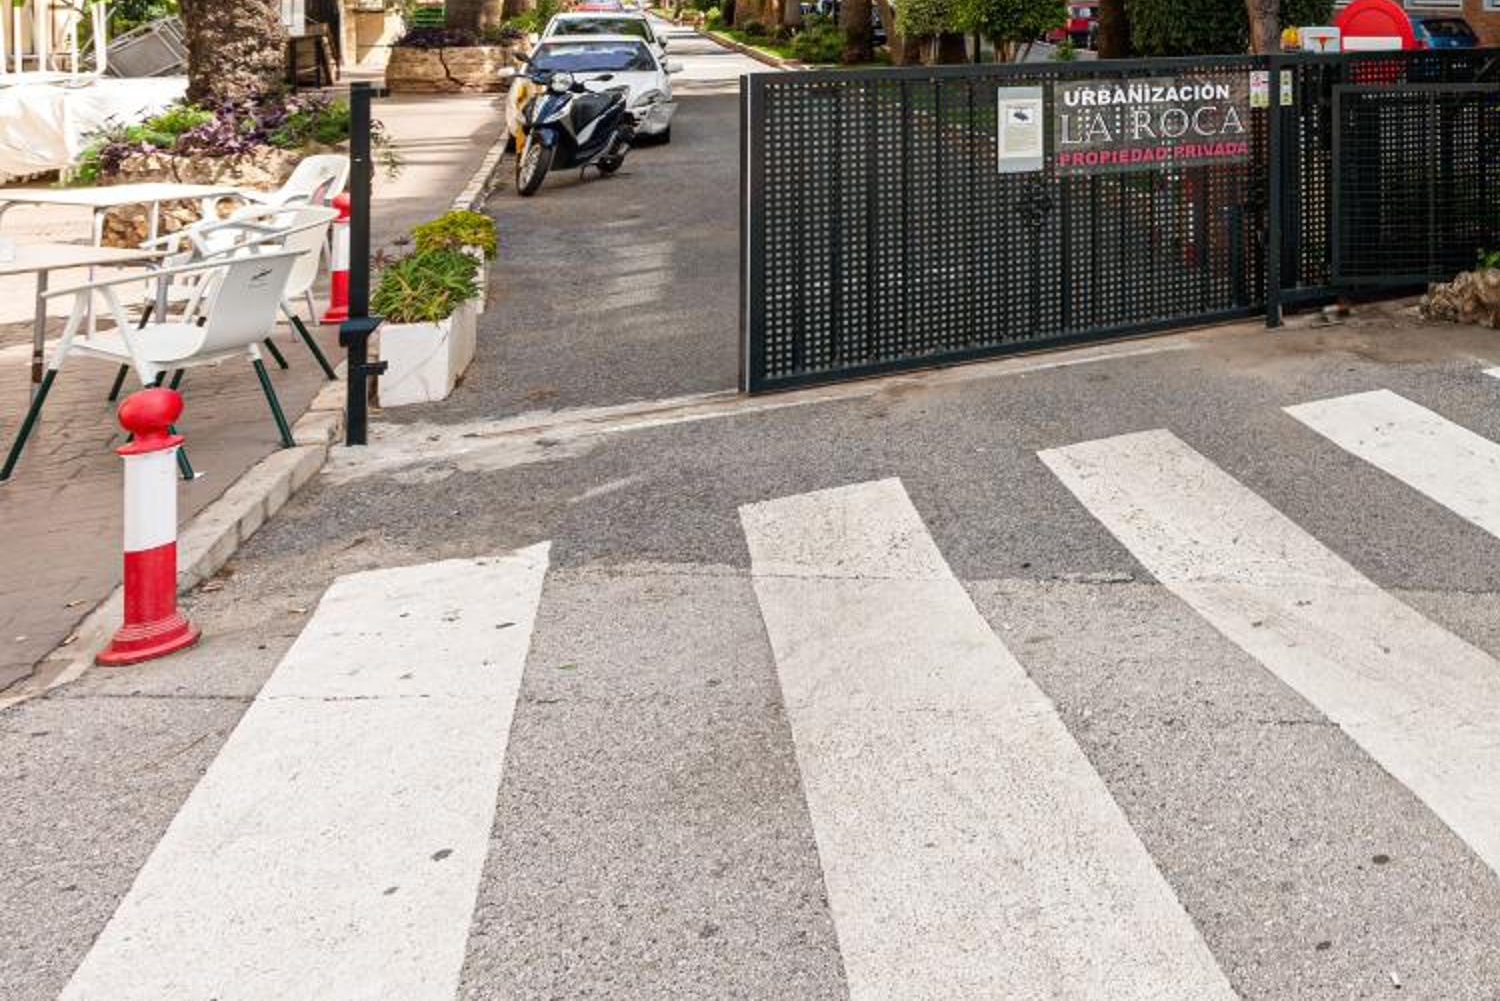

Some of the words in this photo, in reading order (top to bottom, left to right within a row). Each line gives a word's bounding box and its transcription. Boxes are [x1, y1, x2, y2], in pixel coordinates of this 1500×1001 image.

[1064, 82, 1230, 107] URBANIZACIÓN
[1060, 112, 1113, 144] LA
[1132, 105, 1246, 140] ROCA
[1058, 147, 1168, 167] PROPIEDAD
[1173, 142, 1249, 158] PRIVADA
